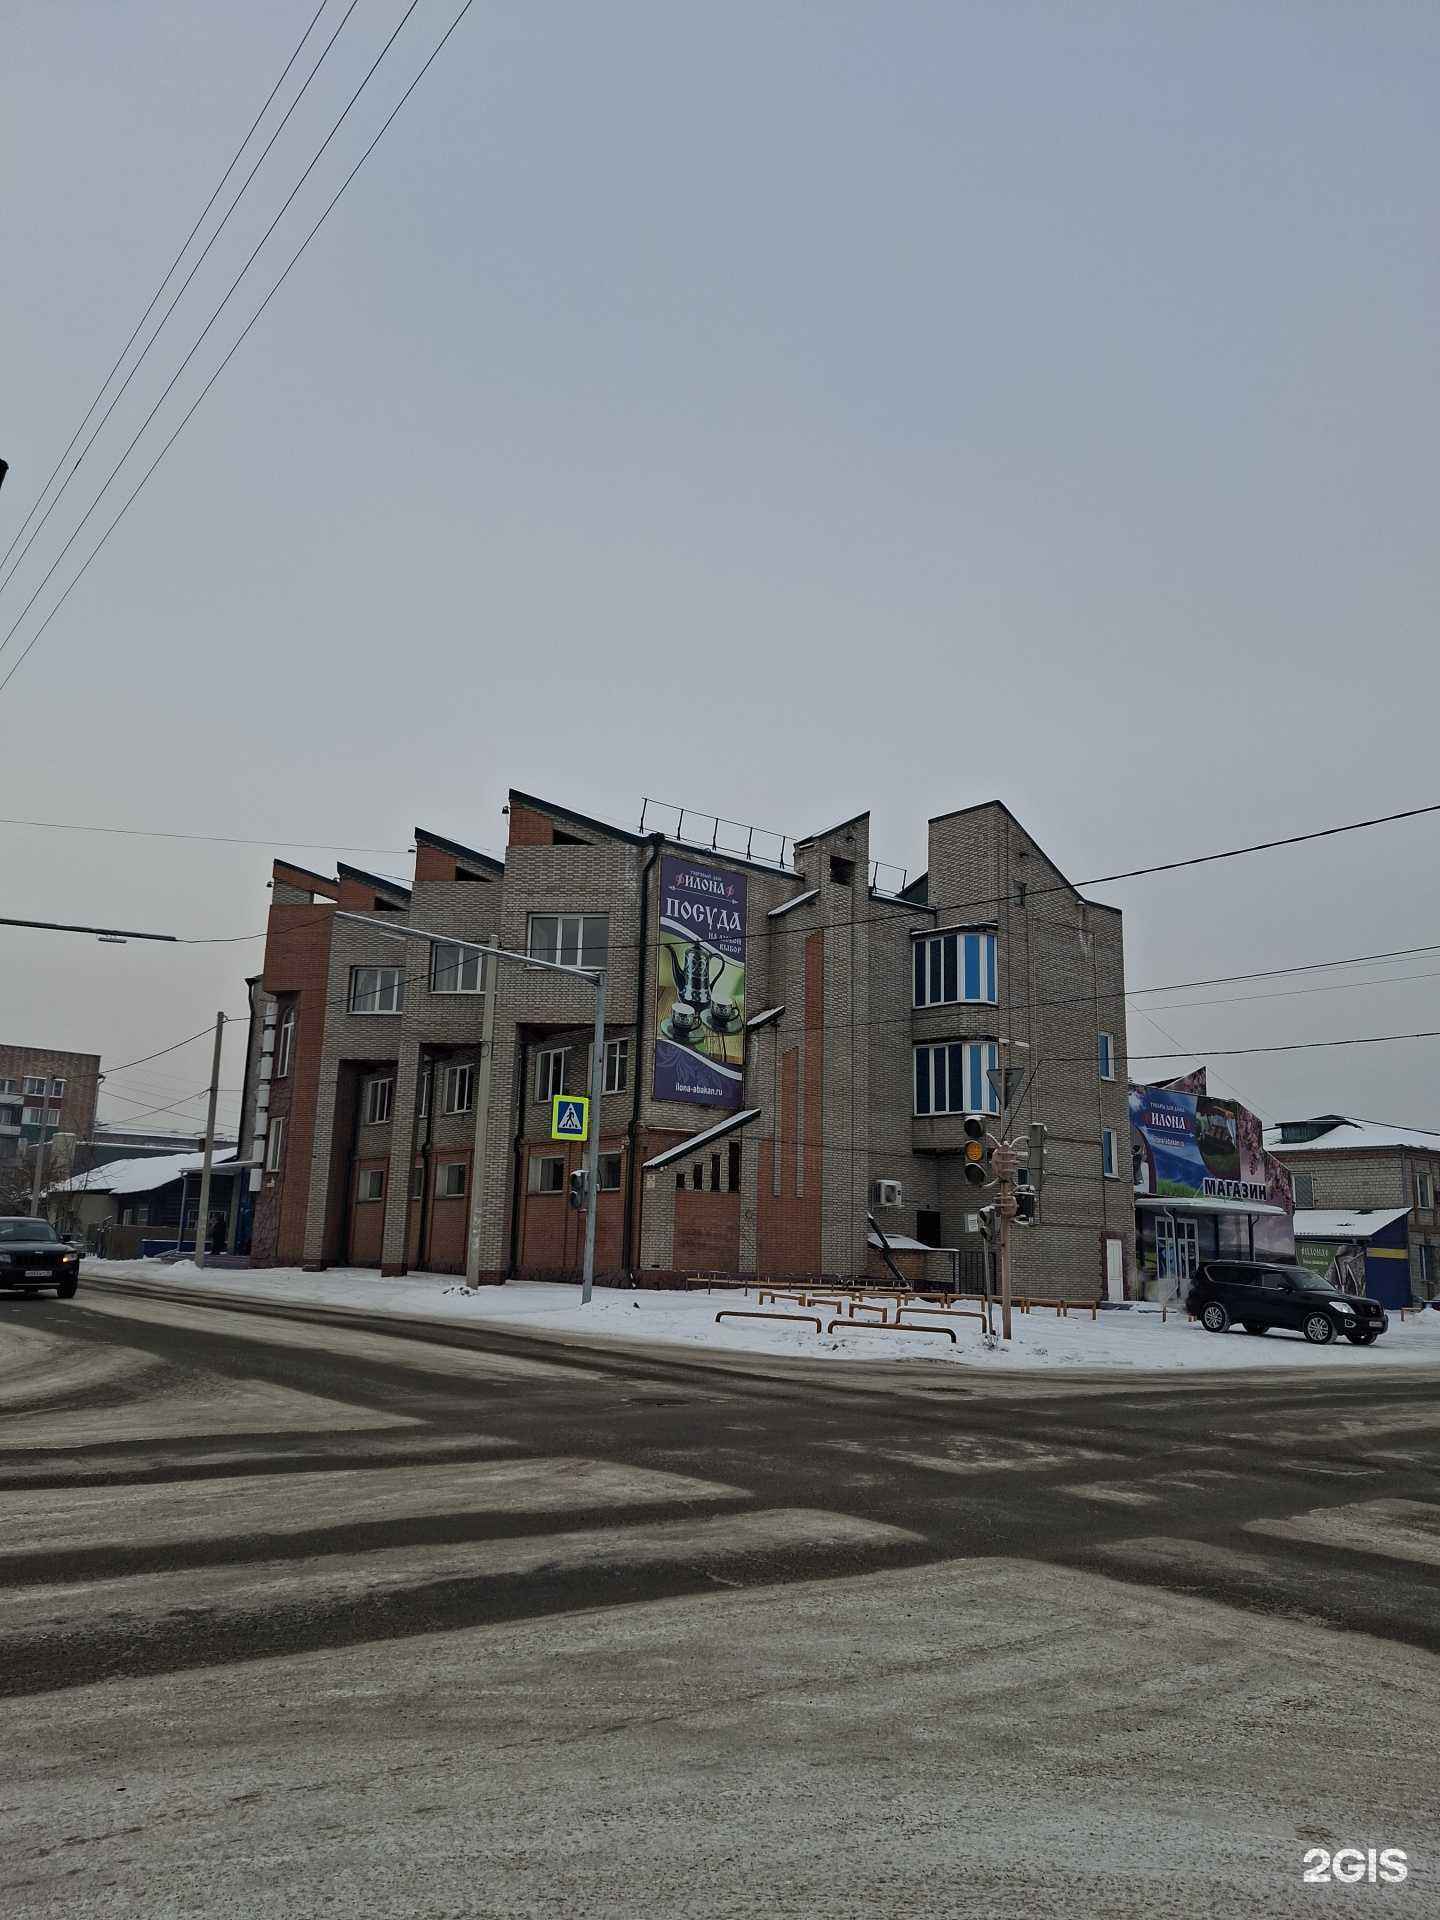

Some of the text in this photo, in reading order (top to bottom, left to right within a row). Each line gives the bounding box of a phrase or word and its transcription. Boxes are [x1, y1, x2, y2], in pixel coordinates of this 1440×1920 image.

[685, 874, 725, 896] ИЛОНА
[666, 897, 742, 932] ПОСУДА
[719, 943, 742, 954] ВЫБОР
[675, 1081, 723, 1096] ilona-abakan.ru
[1151, 1112, 1186, 1130] ИЛОНА
[1204, 1178, 1267, 1201] МАГАЗИН
